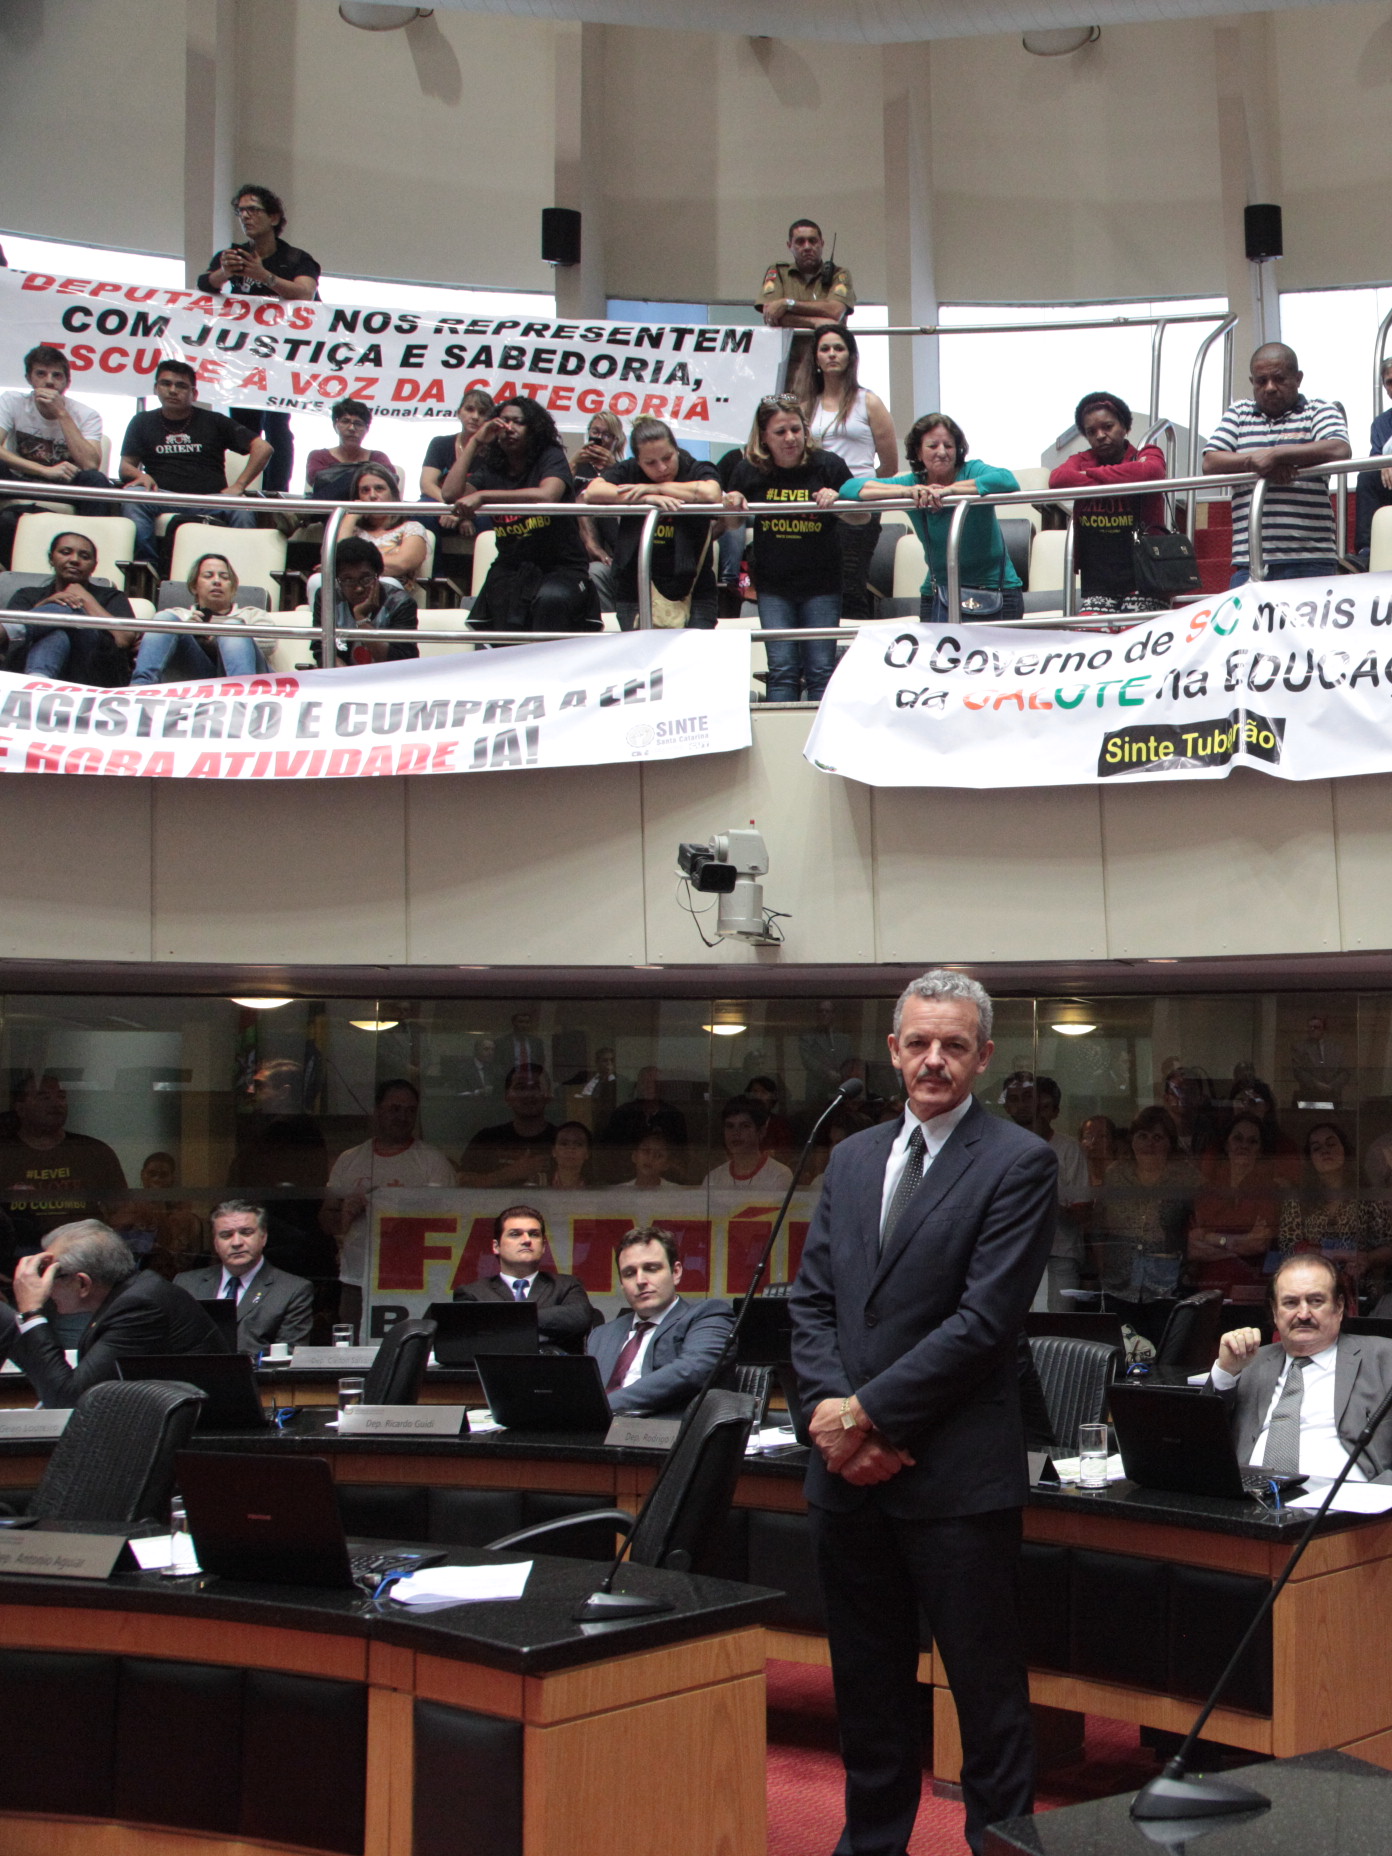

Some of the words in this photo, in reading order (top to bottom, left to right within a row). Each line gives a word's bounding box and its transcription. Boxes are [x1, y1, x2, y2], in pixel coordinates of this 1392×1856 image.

[329, 307, 418, 335] NOS
[433, 317, 754, 354] REPRESENTEM
[61, 305, 172, 339] COM
[181, 324, 384, 372] JUSTIÇA
[399, 344, 429, 369] E
[441, 343, 704, 392] SABEDORIA,
[237, 366, 269, 391] A
[290, 372, 381, 401] VOZ
[391, 378, 445, 404] DA
[266, 396, 324, 410] SINTE
[155, 444, 202, 454] ORIENT
[766, 487, 809, 501] #LEVEI
[507, 515, 551, 535] COLOMBO
[771, 519, 822, 533] COLOMBO
[884, 633, 920, 669] O
[929, 636, 1112, 677] Governo
[1124, 630, 1175, 665] de
[1186, 595, 1243, 644] SC
[1252, 589, 1355, 634] mais
[0, 690, 283, 741] AGISTERIO
[295, 701, 323, 739] E
[335, 695, 546, 737] CUMPRA
[559, 689, 587, 711] A
[600, 668, 663, 708] LEI
[896, 687, 949, 710] da
[962, 674, 1152, 711] CALOTE
[1155, 668, 1210, 701] na
[656, 716, 709, 738] SINTE
[656, 737, 677, 746] Santa
[679, 733, 709, 742] Catarina
[1104, 735, 1175, 764] Sinte
[1181, 719, 1275, 758] Tubarão
[24, 741, 175, 777] HORA
[185, 740, 459, 779] ATIVIDADE
[378, 1206, 811, 1296] FAMÍ
[385, 1419, 412, 1428] Ricardo
[414, 1419, 434, 1428] Guidi
[625, 1432, 640, 1443] Dep.
[643, 1433, 671, 1445] Rodrigo
